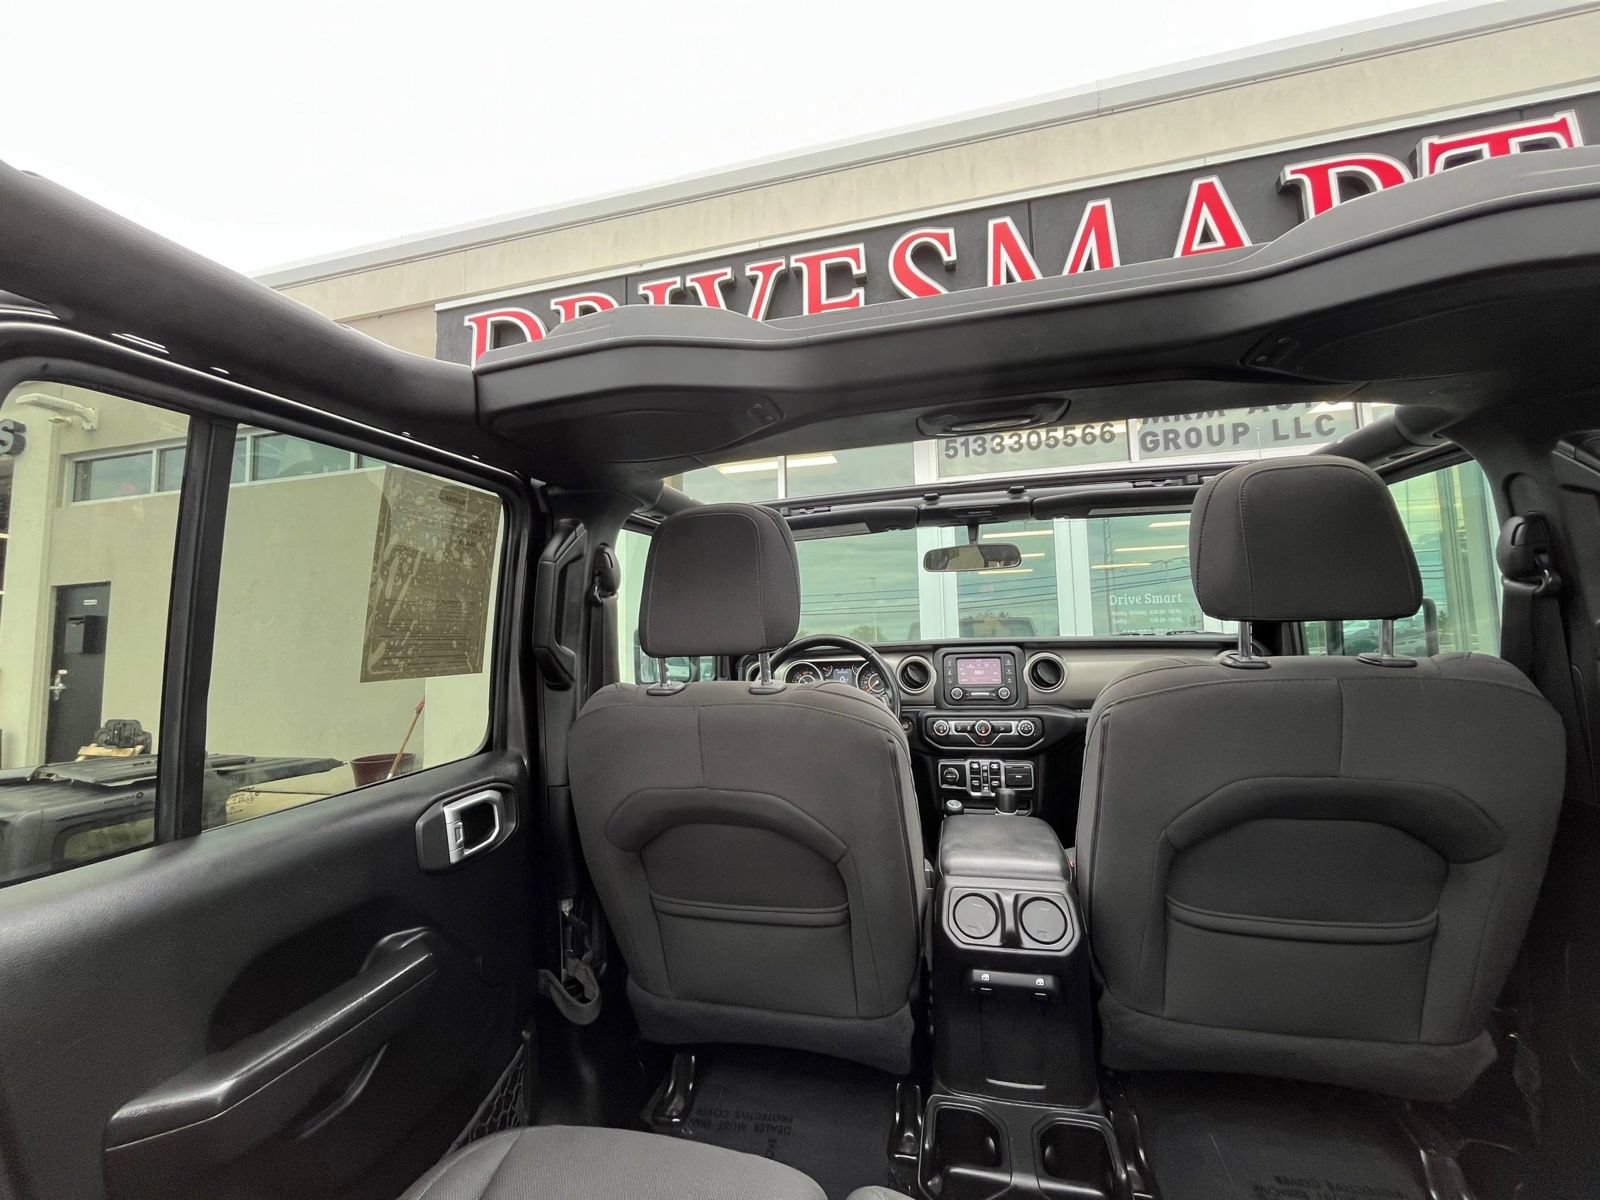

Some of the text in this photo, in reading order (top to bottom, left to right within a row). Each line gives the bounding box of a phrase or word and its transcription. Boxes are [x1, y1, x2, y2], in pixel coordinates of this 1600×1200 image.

[944, 421, 1116, 459] 5133305566
[1140, 413, 1336, 453] GROUP LLC
[1109, 593, 1183, 606] Drive Smart
